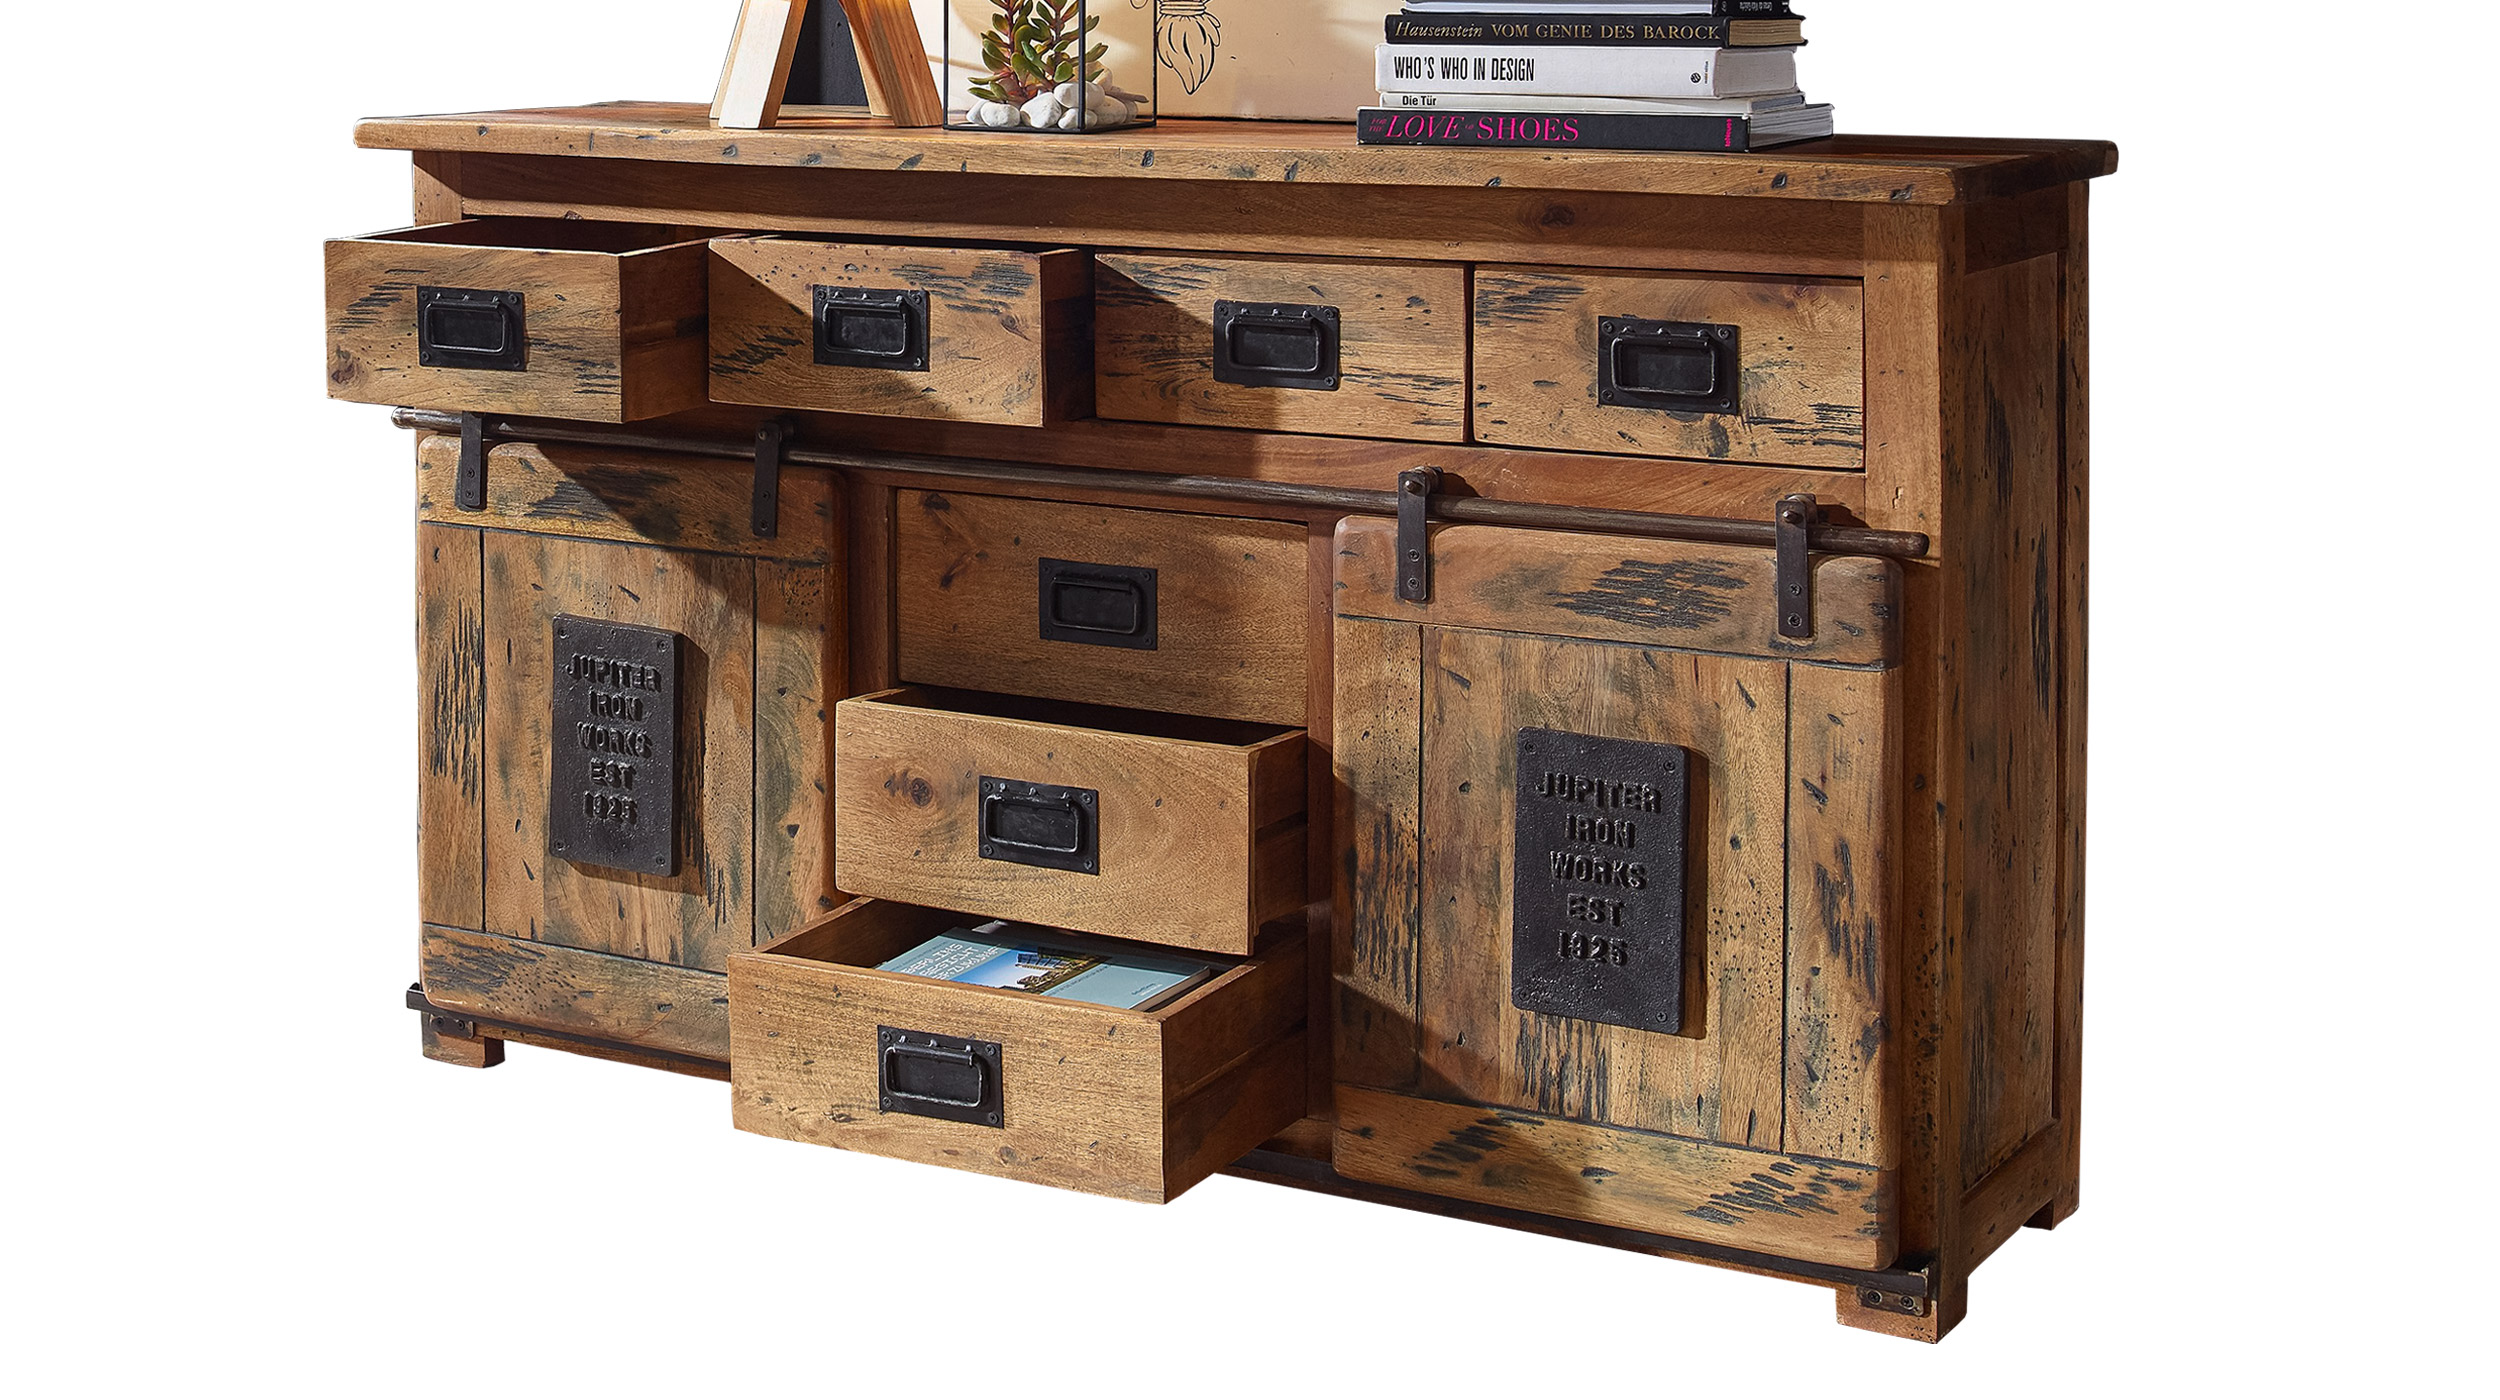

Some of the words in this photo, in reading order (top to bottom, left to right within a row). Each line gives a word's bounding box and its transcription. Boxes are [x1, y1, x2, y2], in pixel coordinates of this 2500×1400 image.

[1394, 21, 1483, 39] Hausenstein
[1491, 24, 1529, 38] VOM
[1537, 24, 1592, 39] GENIE
[1600, 25, 1635, 39] DES
[1643, 25, 1721, 40] BAROCK
[1394, 56, 1435, 80] WHO'S
[1441, 57, 1468, 81] WHO
[1473, 57, 1486, 81] IN
[1491, 58, 1535, 82] DESIGN
[1402, 95, 1418, 105] Die
[1420, 95, 1437, 106] Tür
[1385, 115, 1464, 139] LOVE
[1477, 116, 1579, 141] SHOES
[566, 653, 662, 692] JUPITER
[588, 688, 644, 721] IRON
[577, 721, 653, 758] WORKS
[590, 758, 637, 790] EST
[583, 790, 639, 825] 1925
[1535, 772, 1662, 813] JUPITER
[1565, 813, 1636, 848] IRON
[1549, 850, 1648, 890] WORKS
[1567, 893, 1626, 928] EST
[1558, 930, 1629, 967] 1925
